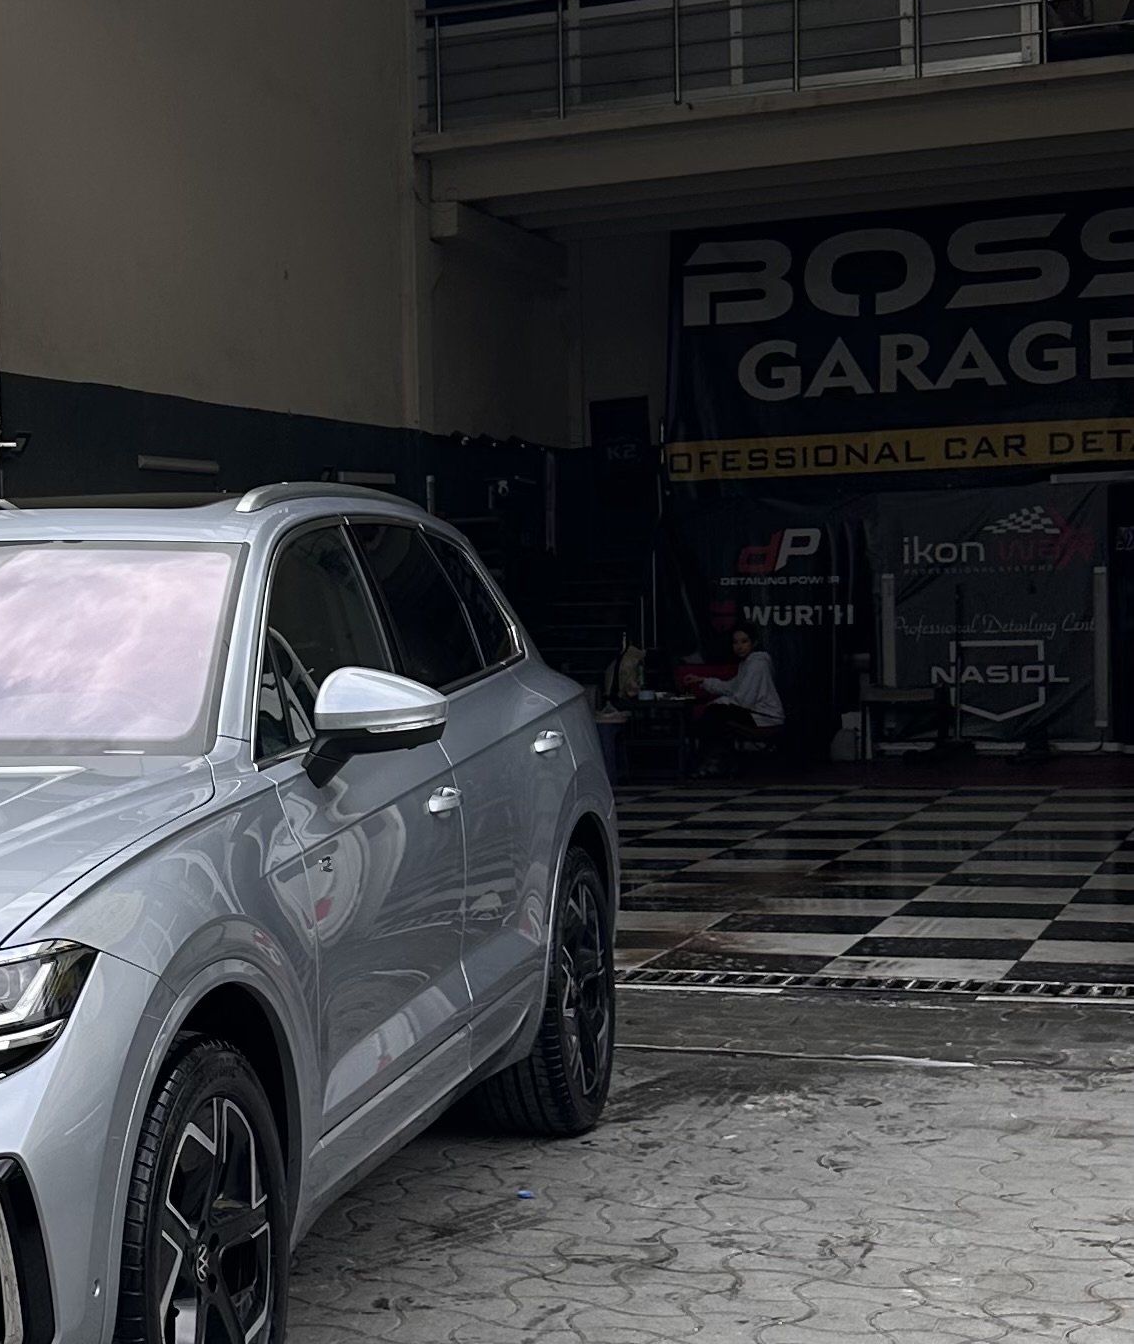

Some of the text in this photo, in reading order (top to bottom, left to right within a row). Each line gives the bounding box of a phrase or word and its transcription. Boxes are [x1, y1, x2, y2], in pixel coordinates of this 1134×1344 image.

[944, 434, 1027, 461] CAR
[903, 535, 986, 565] ikon
[720, 576, 786, 587] DETAILING
[931, 663, 1070, 685] NASIOL
